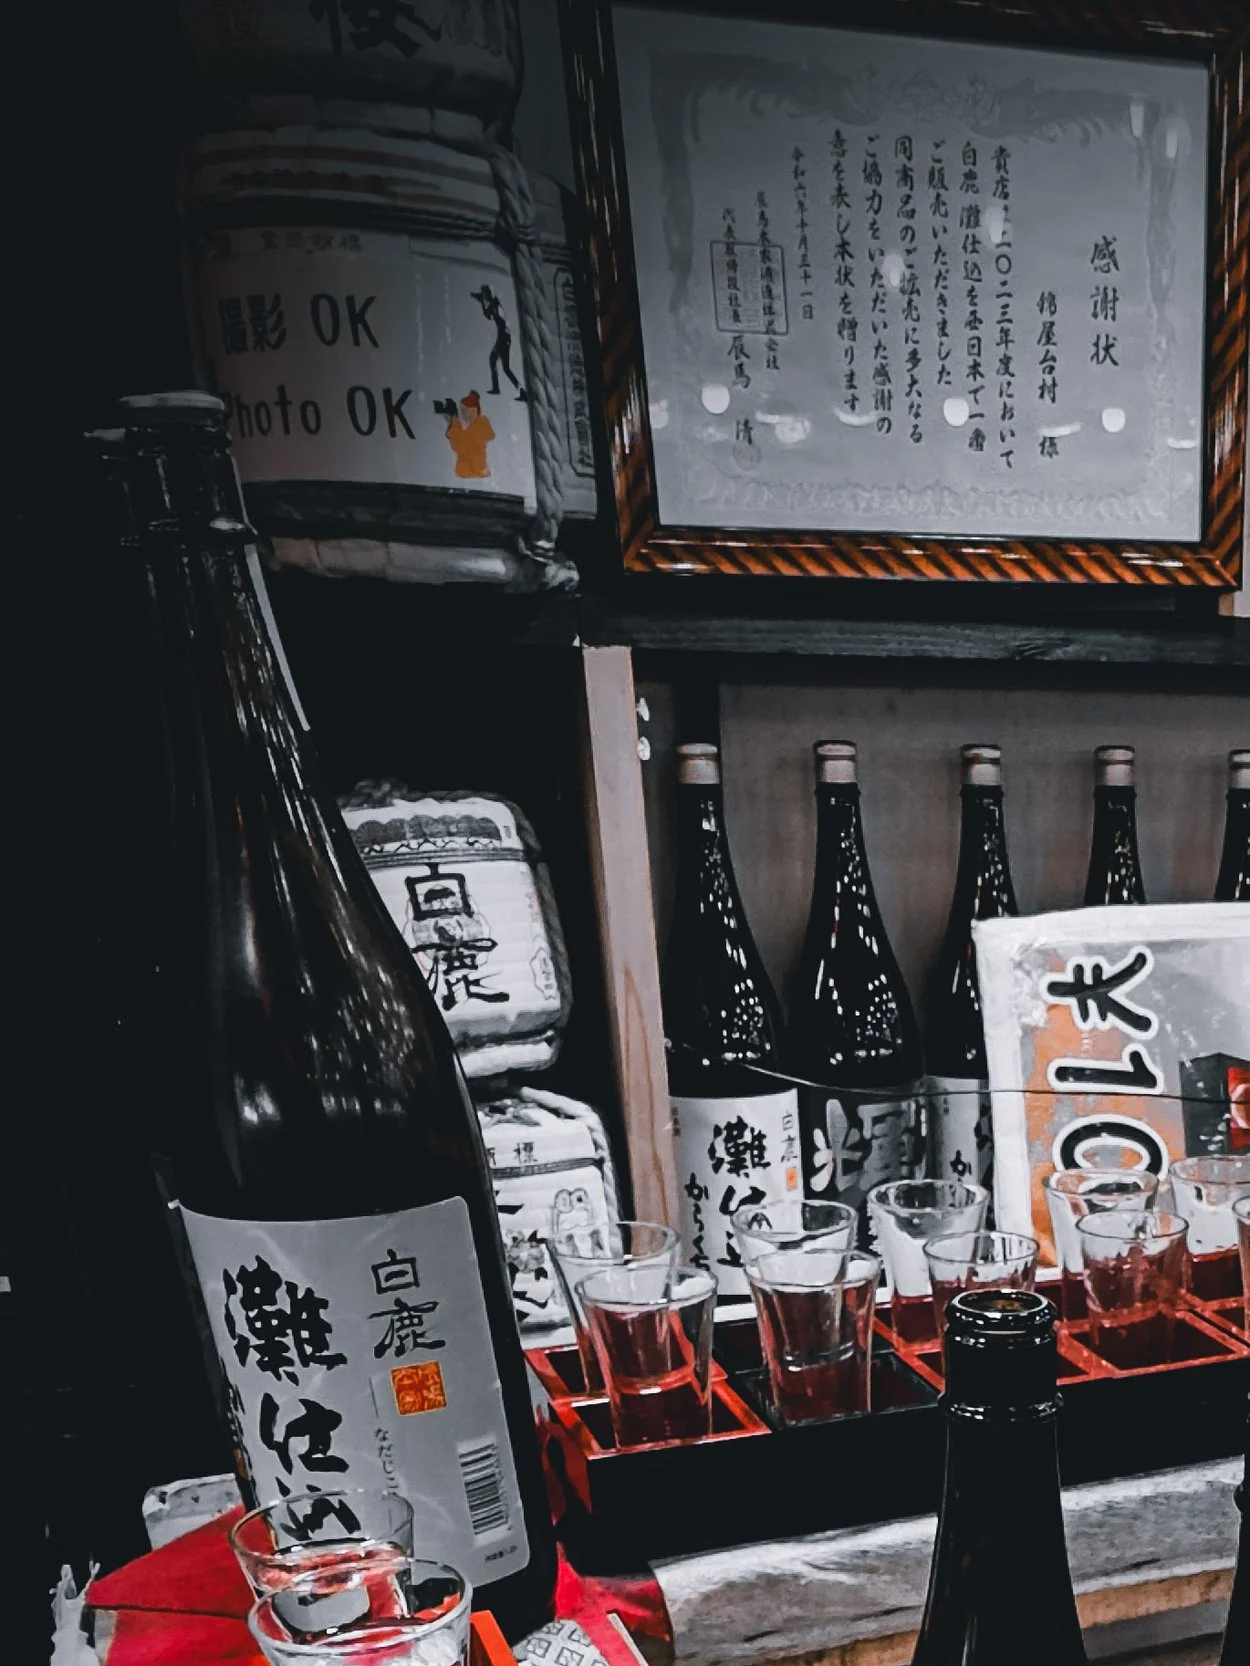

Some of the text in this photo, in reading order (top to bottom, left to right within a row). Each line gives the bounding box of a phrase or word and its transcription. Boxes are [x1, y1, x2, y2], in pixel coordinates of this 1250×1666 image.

[219, 294, 379, 355] 撮影 OK
[1088, 236, 1121, 368] 感謝状
[346, 385, 415, 439] OK
[404, 862, 510, 1012] 白鹿
[1046, 950, 1165, 1205] ¥10
[366, 1248, 447, 1360] 白鹿
